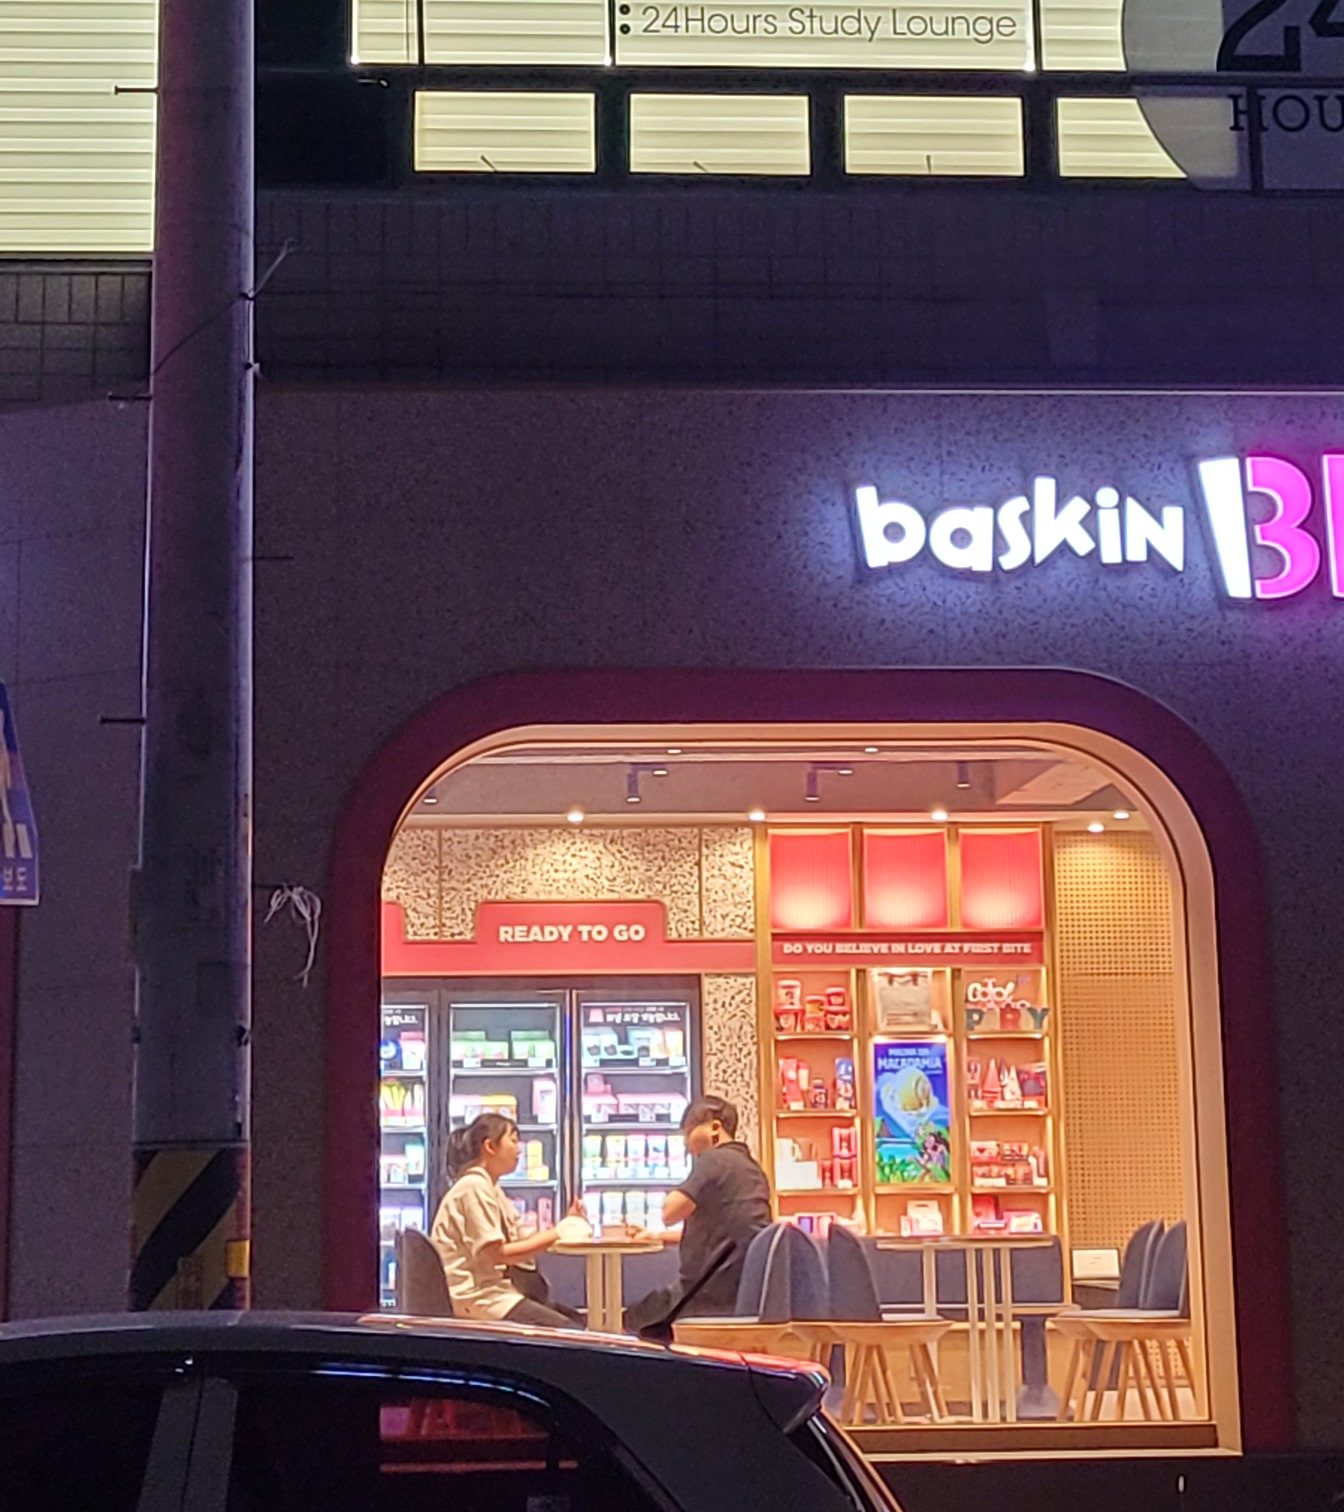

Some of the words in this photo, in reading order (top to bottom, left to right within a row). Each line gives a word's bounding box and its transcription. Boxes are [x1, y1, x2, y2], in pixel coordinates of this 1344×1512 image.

[643, 5, 777, 37] 24Hours
[787, 8, 882, 44] Study
[891, 8, 1017, 44] Lounge
[855, 475, 1186, 573] baskin
[498, 924, 573, 943] READY
[577, 924, 608, 942] TO
[612, 924, 646, 942] GO
[783, 942, 802, 954] DO
[806, 942, 832, 954] YOU
[835, 942, 889, 954] BELIEVE
[907, 942, 942, 954] LOVE
[944, 942, 960, 954] AT
